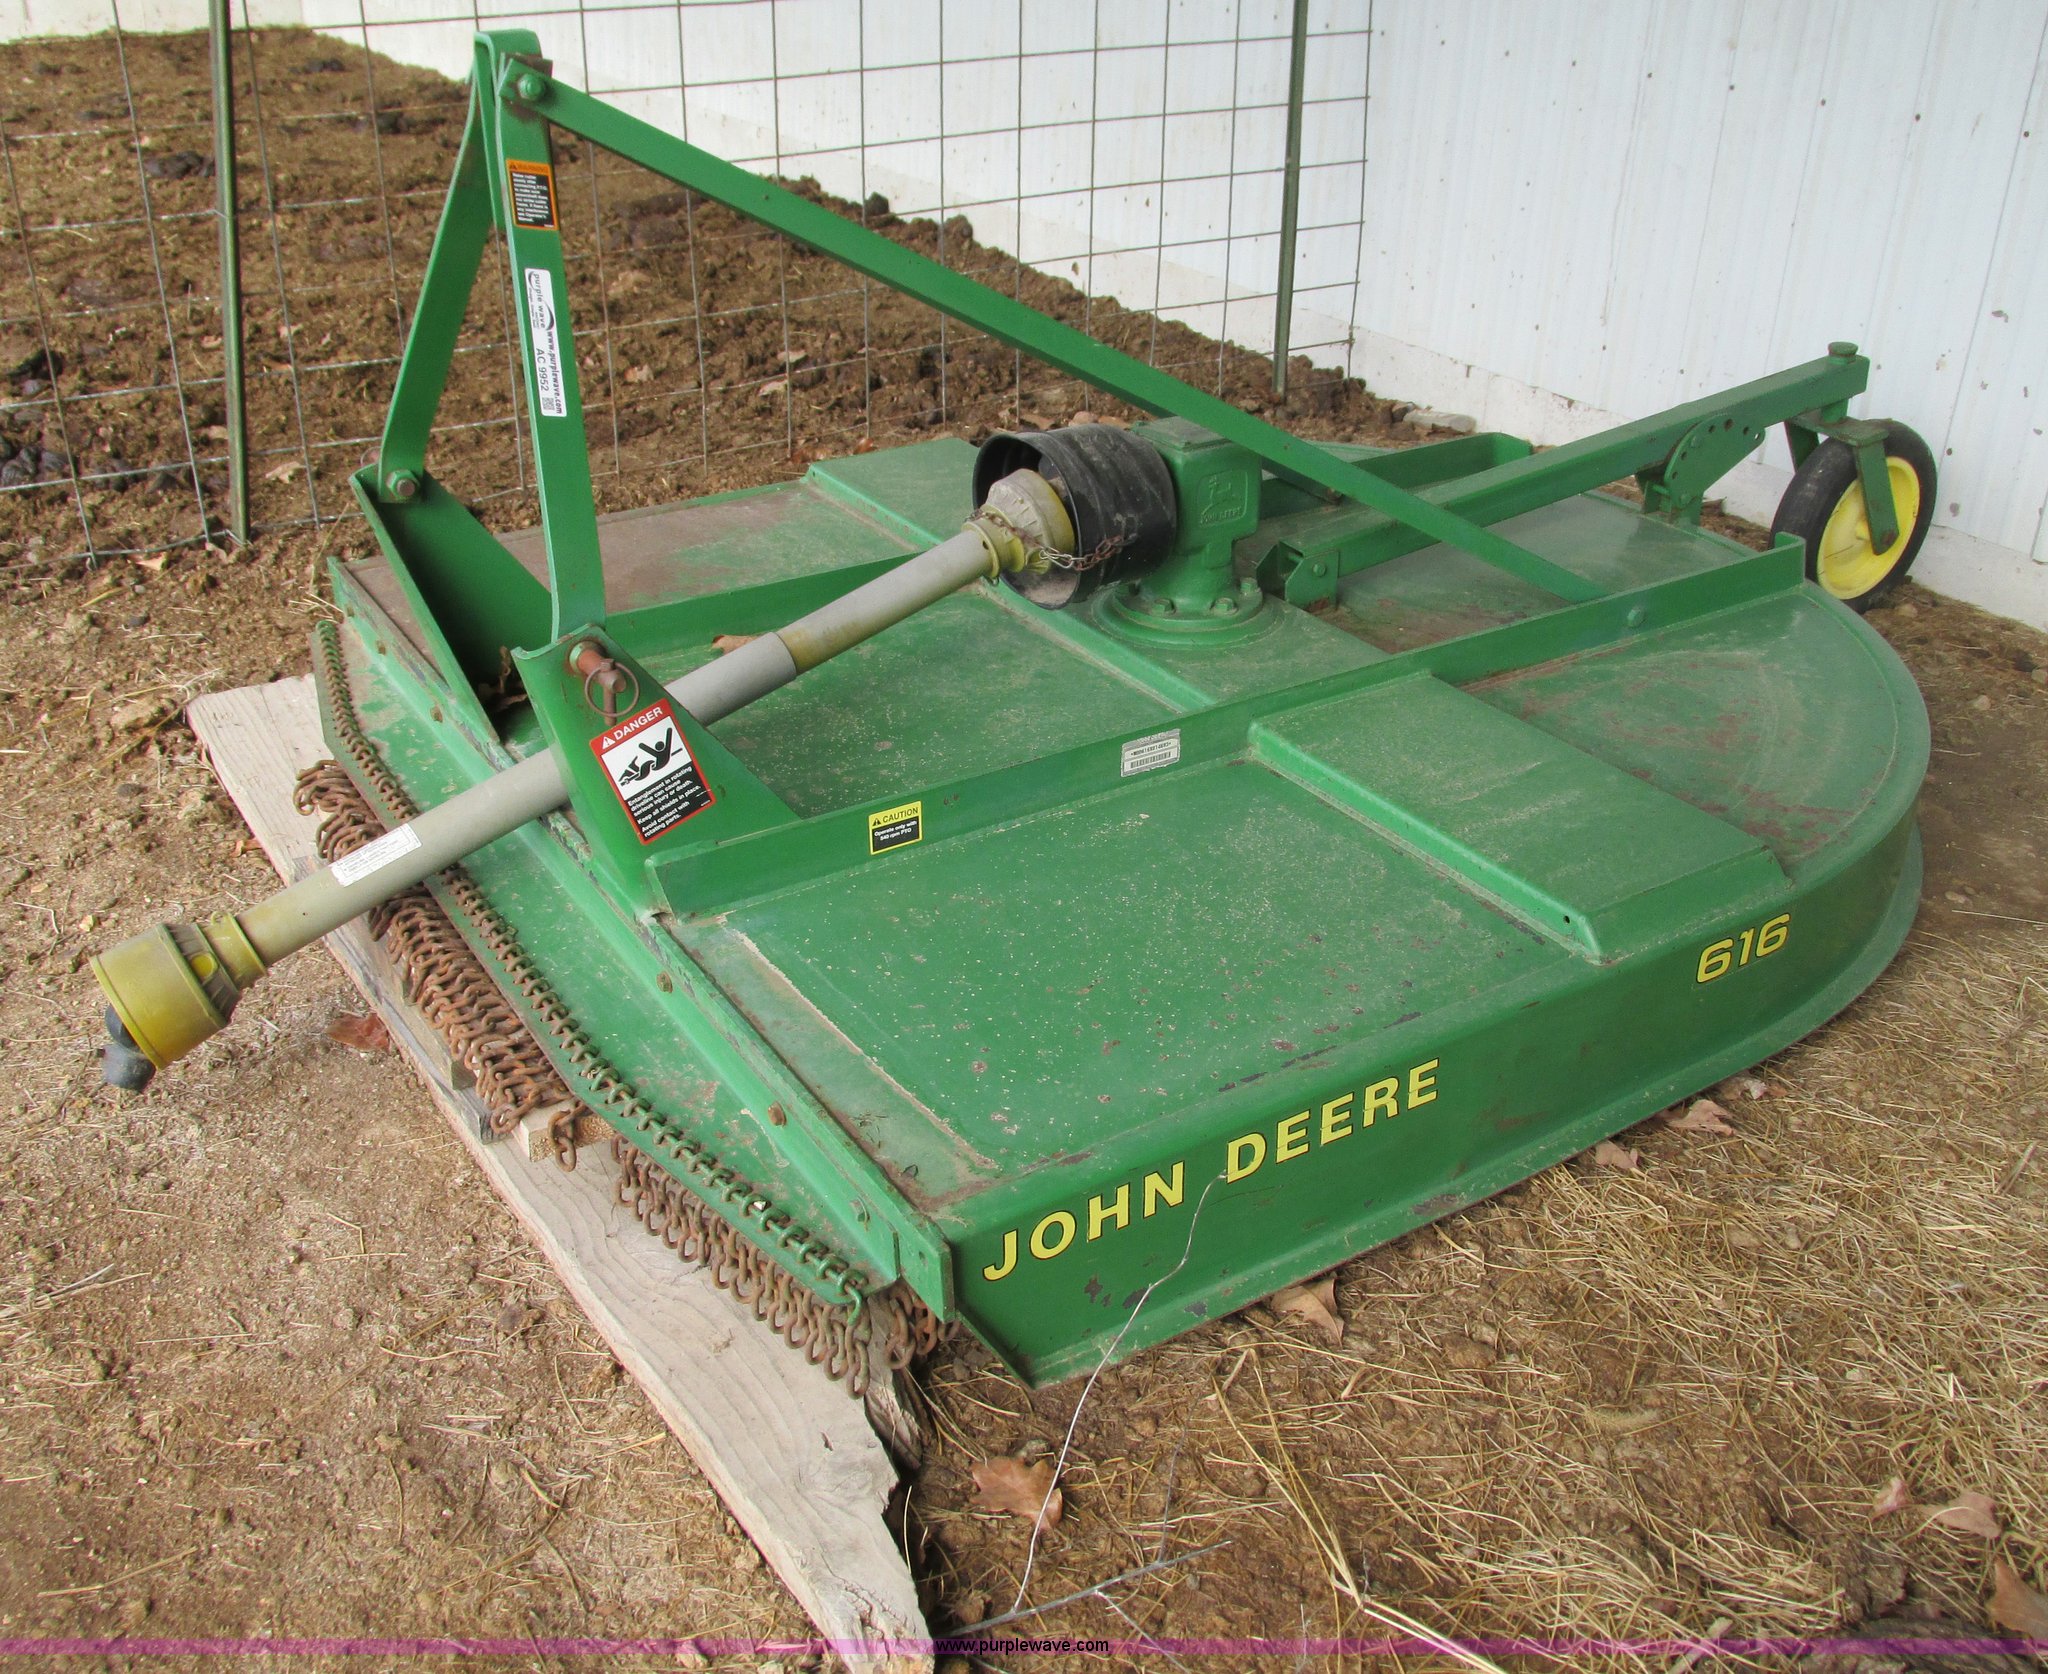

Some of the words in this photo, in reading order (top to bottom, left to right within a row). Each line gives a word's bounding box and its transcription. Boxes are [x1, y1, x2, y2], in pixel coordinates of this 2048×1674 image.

[533, 273, 543, 303] purple
[538, 305, 546, 329] wave
[536, 347, 546, 363] AC
[539, 367, 549, 392] 9952
[546, 331, 563, 414] www.purplewave.com
[613, 706, 663, 740] DANGER
[627, 781, 665, 807] Entanglement
[670, 766, 692, 781] rotating
[630, 796, 654, 811] driveline
[653, 789, 665, 798] can
[664, 780, 681, 791] cause
[633, 803, 654, 817] serious
[653, 793, 669, 805] injury
[675, 780, 693, 792] death.
[637, 813, 652, 824] Keep
[659, 798, 679, 811] shields
[684, 785, 702, 798] place.
[642, 820, 657, 832] Avoid
[657, 808, 678, 822] contact
[677, 801, 690, 811] with
[882, 807, 919, 823] CAUTION
[644, 822, 666, 838] rotating
[665, 814, 682, 825] parts.
[874, 827, 895, 837] Operate
[1697, 913, 1791, 983] 616
[982, 1160, 1186, 1281] JOHN
[1225, 1057, 1440, 1185] DEERE
